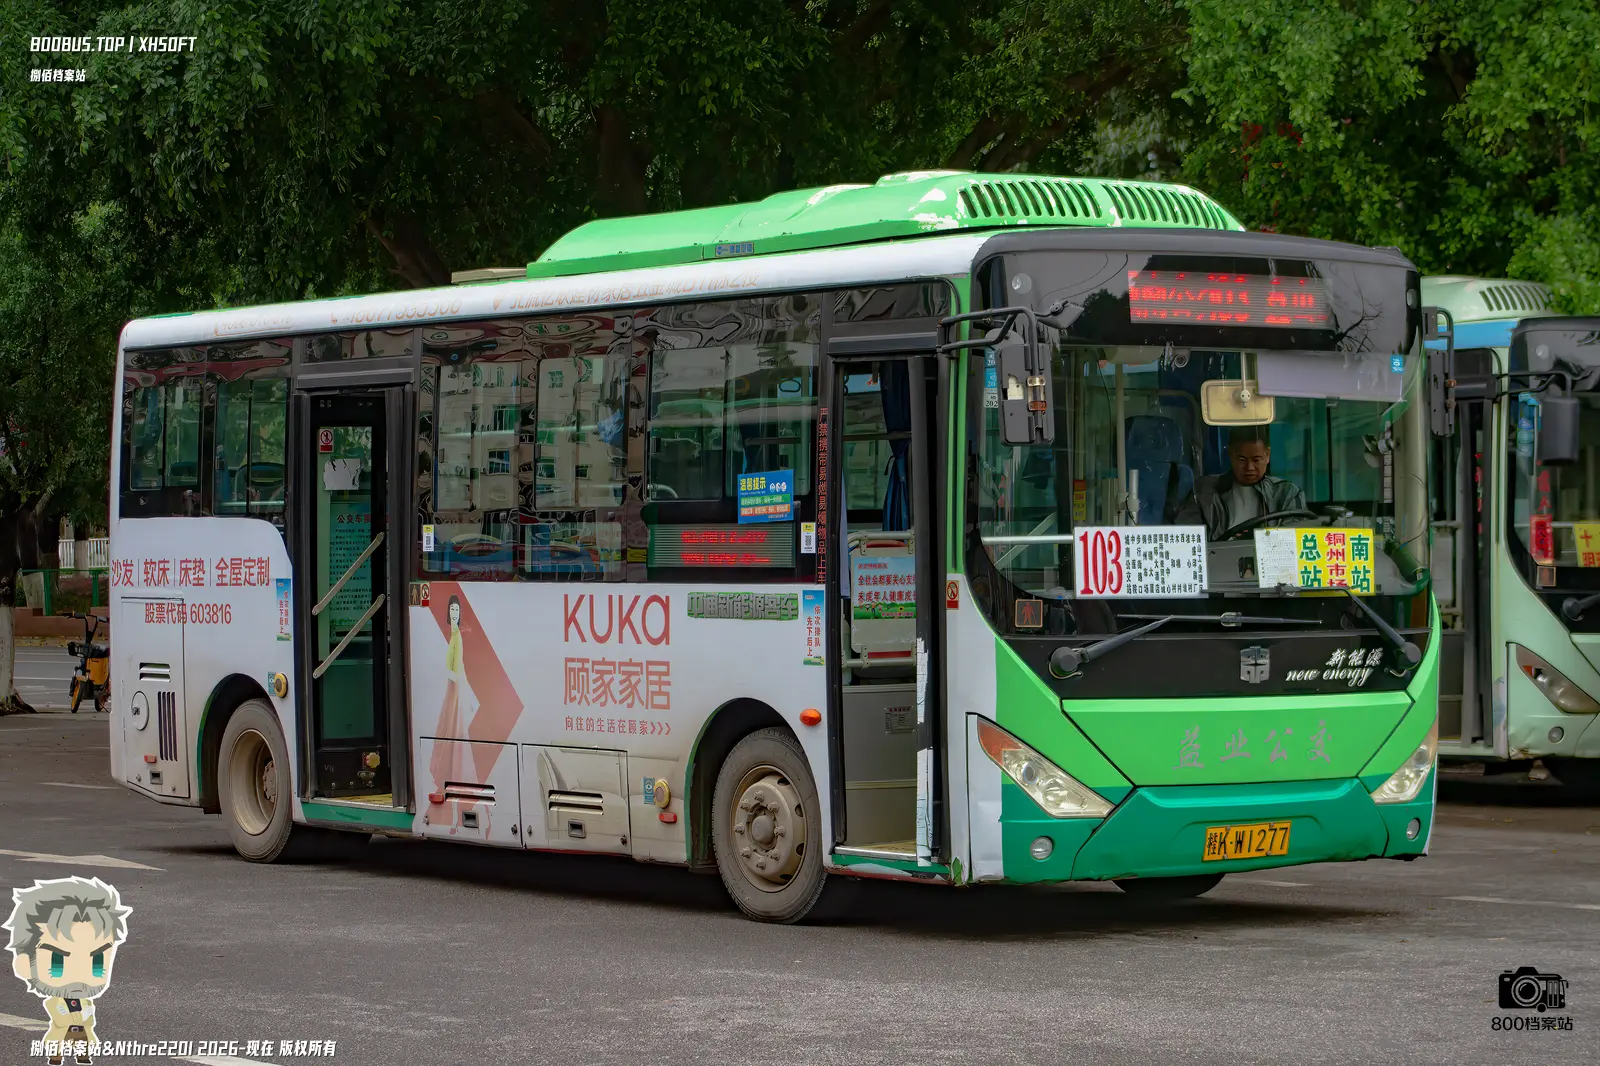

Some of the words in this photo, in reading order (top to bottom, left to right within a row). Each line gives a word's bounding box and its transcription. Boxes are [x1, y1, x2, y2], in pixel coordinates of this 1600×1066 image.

[740, 476, 766, 490] 温馨提示
[818, 408, 828, 584] 严禁携带易燃易爆物品上车
[112, 560, 134, 587] 沙发
[144, 558, 170, 586] 软床
[178, 558, 205, 586] 床垫
[216, 557, 270, 586] 全屋定制
[1079, 530, 1122, 595] 103
[1299, 534, 1322, 588] 总站
[1350, 534, 1370, 592] 南站
[144, 602, 188, 624] 股票代码
[190, 604, 232, 624] 603816
[687, 592, 798, 620] 中通新能源客车
[1326, 648, 1384, 669] 新能源
[564, 657, 672, 710] 顾家家居
[1286, 668, 1320, 682] new
[1322, 668, 1374, 687] energy
[565, 716, 648, 736] 向往的生活在顾家
